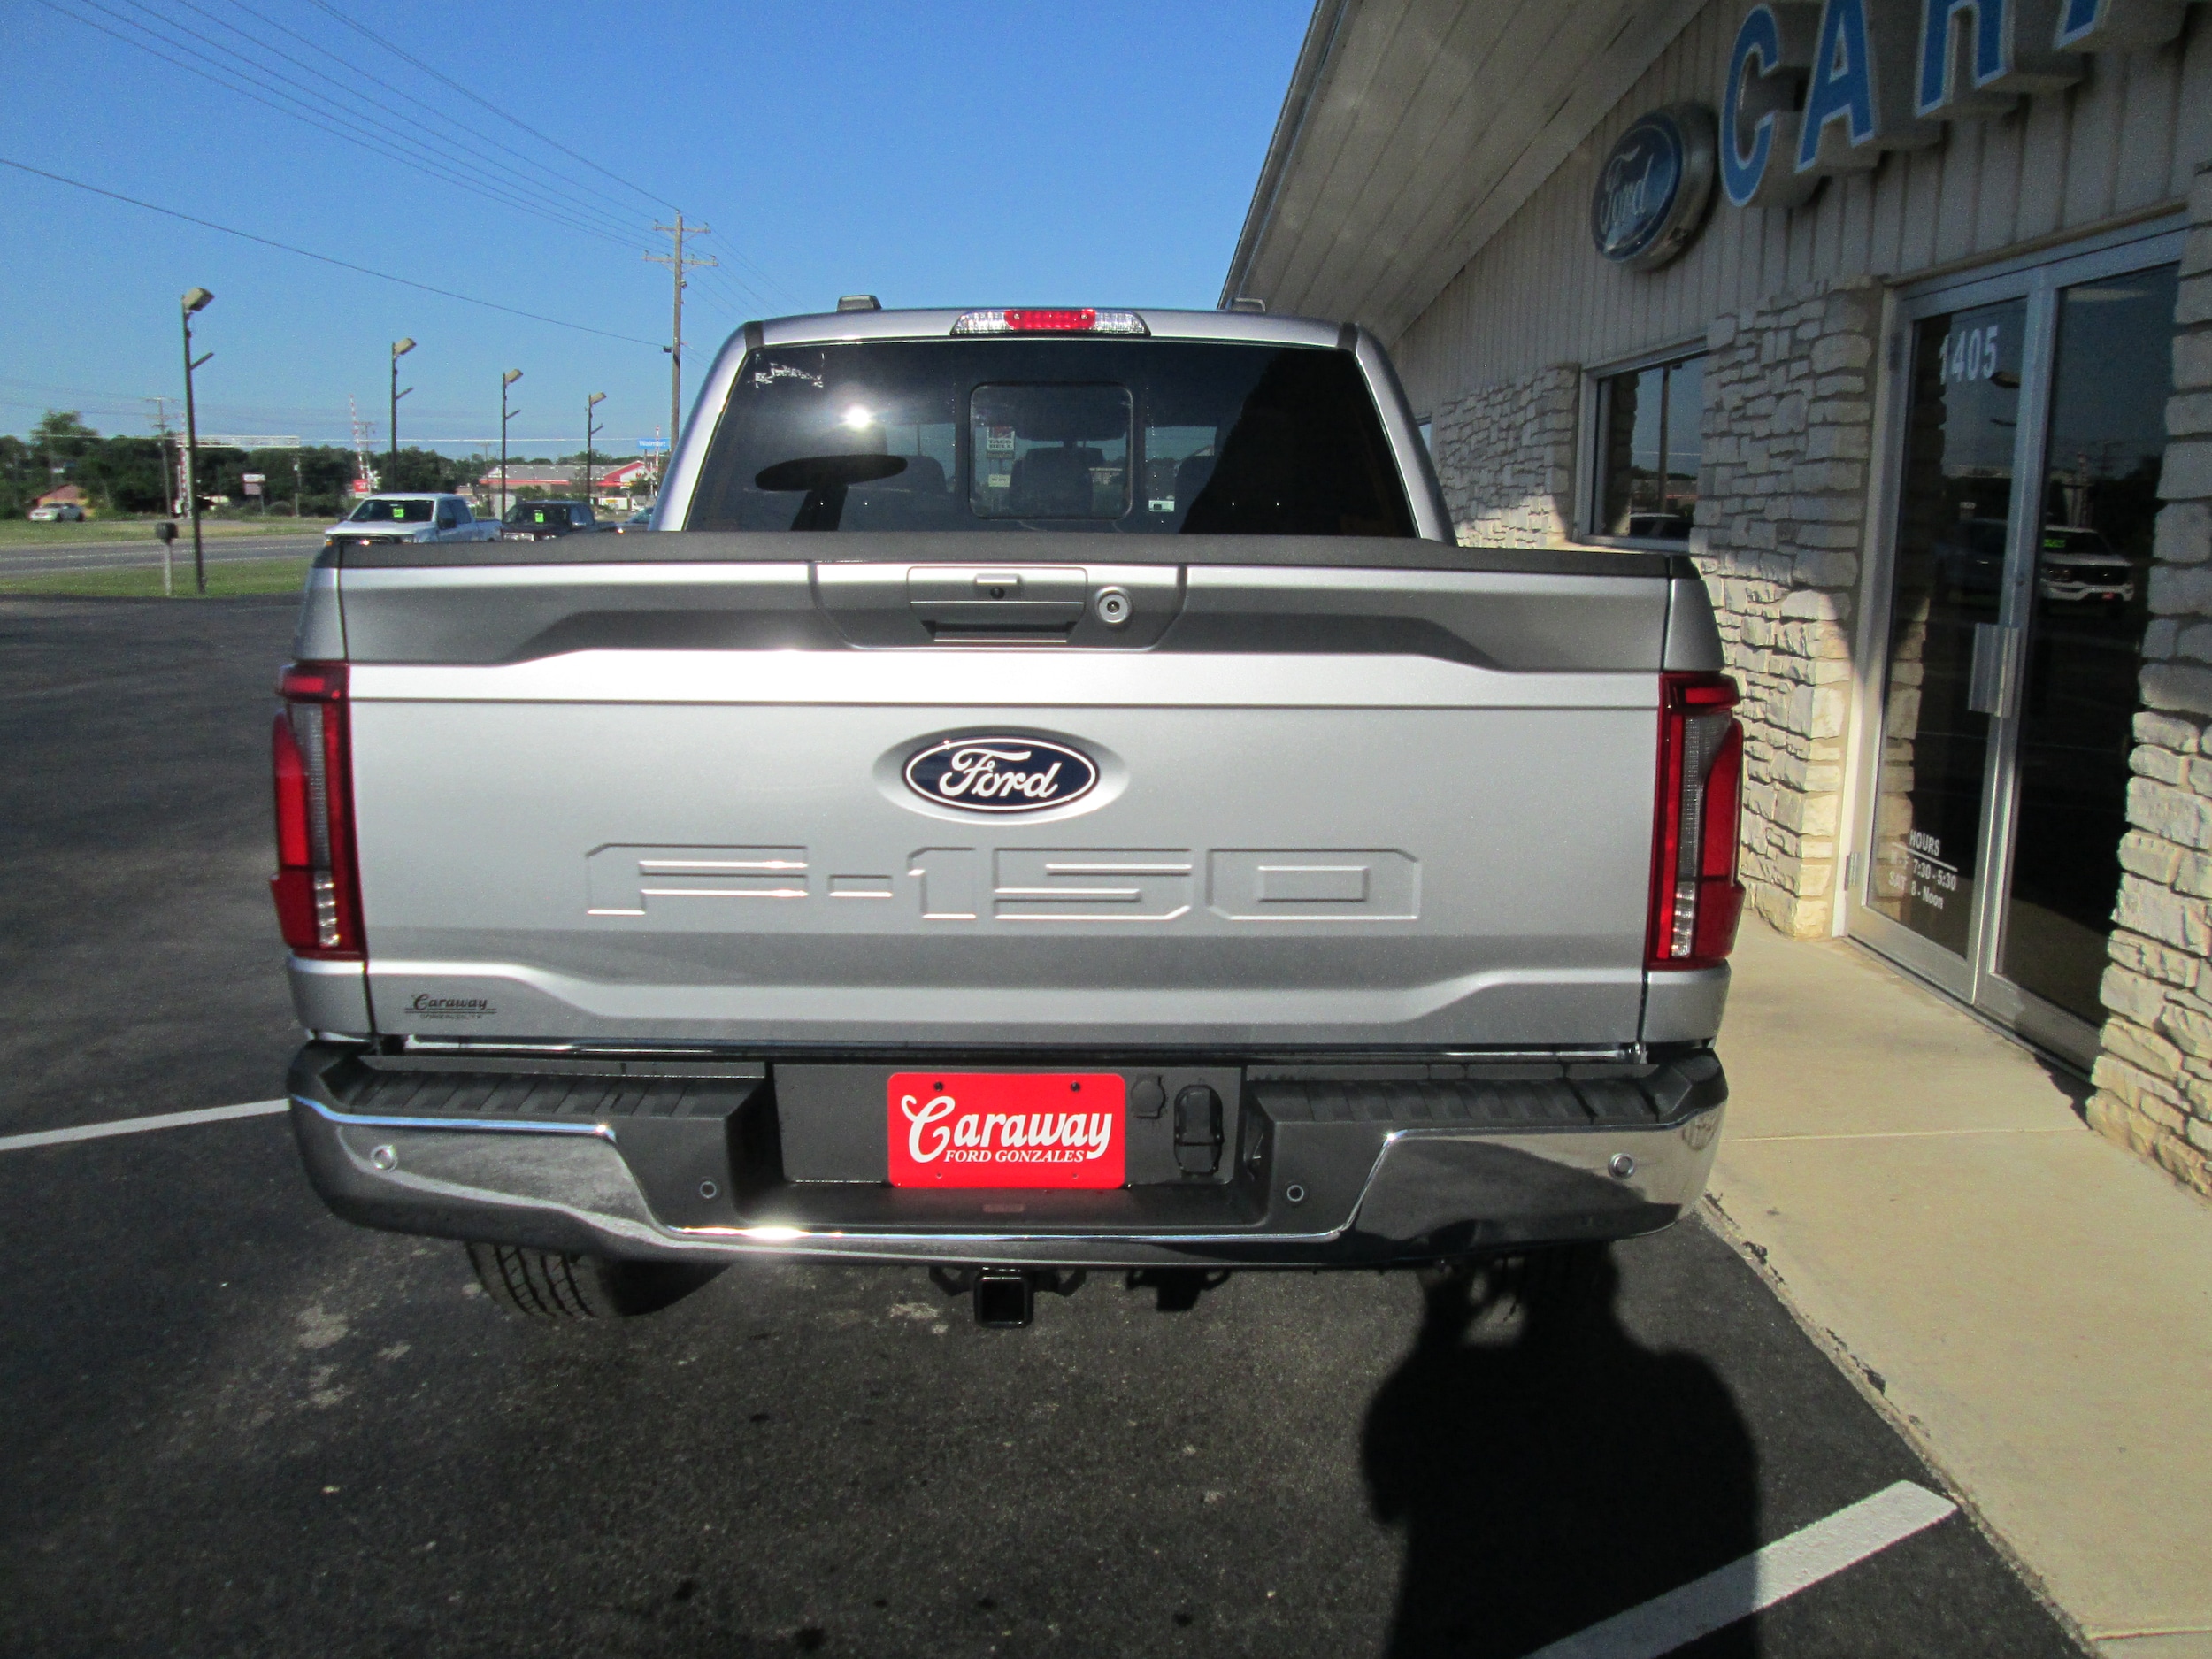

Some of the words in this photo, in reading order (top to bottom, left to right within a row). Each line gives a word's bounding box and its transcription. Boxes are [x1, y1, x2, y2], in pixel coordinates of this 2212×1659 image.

[1719, 0, 2111, 207] CAR
[1600, 144, 1655, 235] Ford
[1939, 325, 1999, 386] 1405
[939, 748, 1062, 798] Ford
[1909, 829, 1940, 856] HOURS
[585, 843, 1419, 919] F-150
[1911, 880, 1917, 896] 8
[1922, 885, 1944, 910] Noon
[1913, 858, 1932, 879] 7:30
[1937, 869, 1957, 892] 5:30
[411, 994, 488, 1010] Caraway
[901, 1094, 1113, 1164] Caraway
[943, 1149, 992, 1164] FORD
[995, 1149, 1085, 1164] GONZALES
